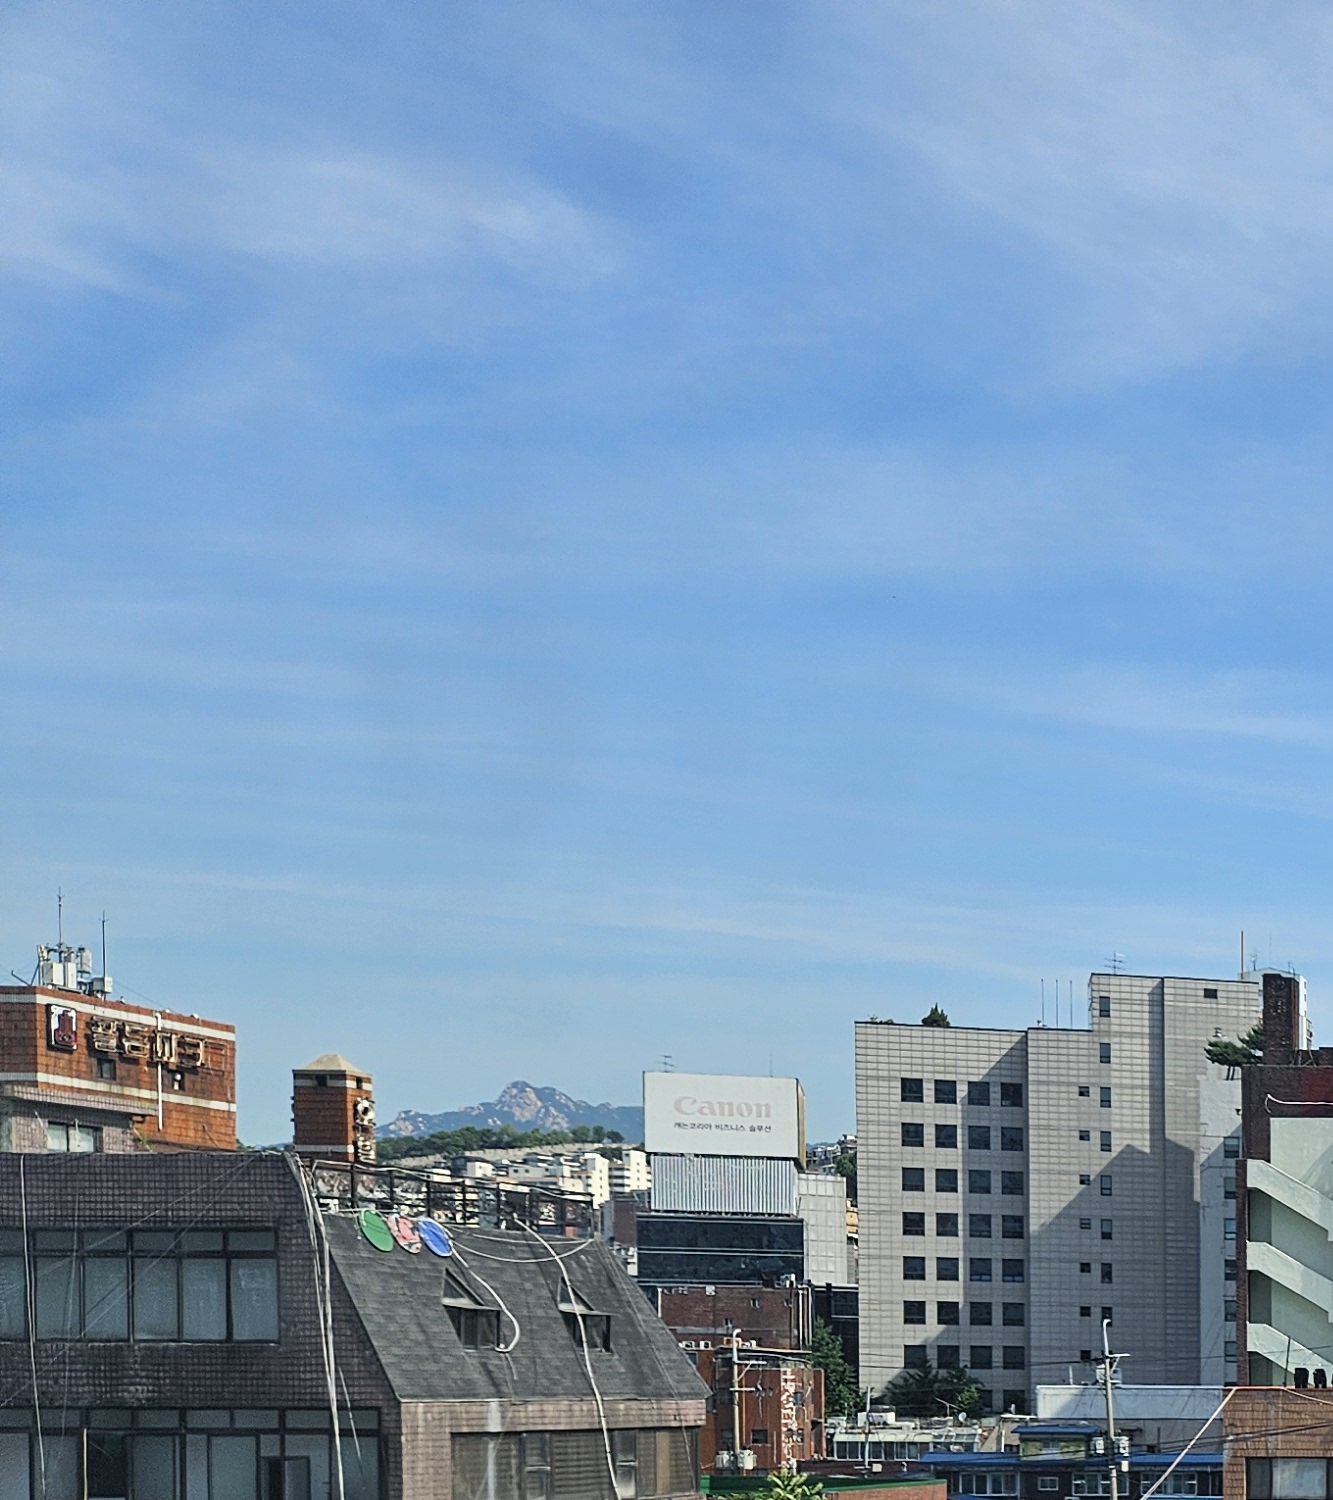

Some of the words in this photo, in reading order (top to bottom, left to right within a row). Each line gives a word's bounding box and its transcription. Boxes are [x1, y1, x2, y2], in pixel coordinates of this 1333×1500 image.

[673, 1096, 772, 1119] Canon
[674, 1122, 712, 1130] 캐논코리아
[715, 1123, 745, 1132] 비즈니스
